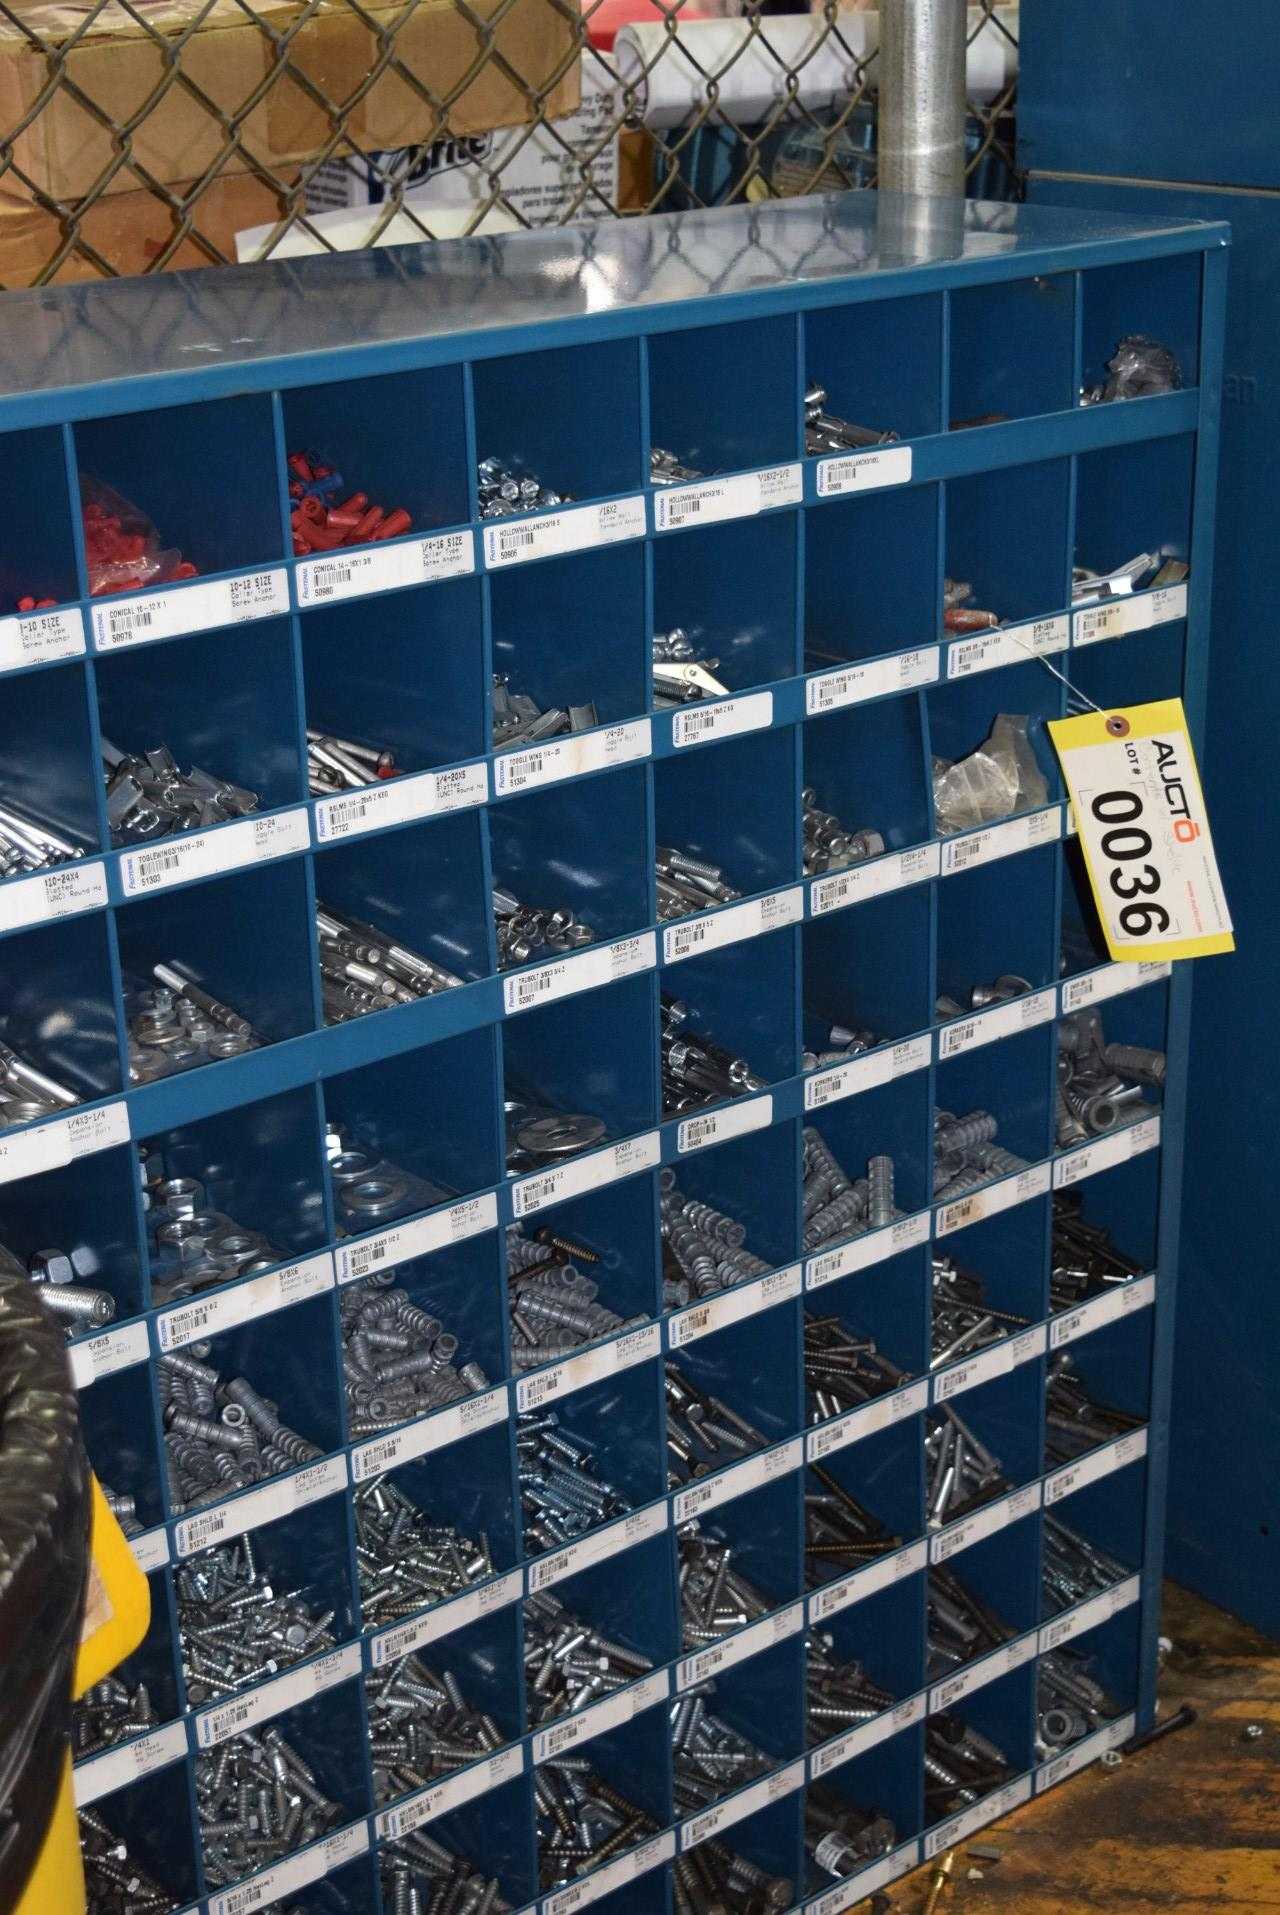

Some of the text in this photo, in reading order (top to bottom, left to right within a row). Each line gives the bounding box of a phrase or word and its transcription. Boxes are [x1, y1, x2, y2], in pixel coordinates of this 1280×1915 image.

[1124, 742, 1139, 765] LOT
[1151, 739, 1201, 843] AUCTO
[1091, 790, 1170, 936] 0036
